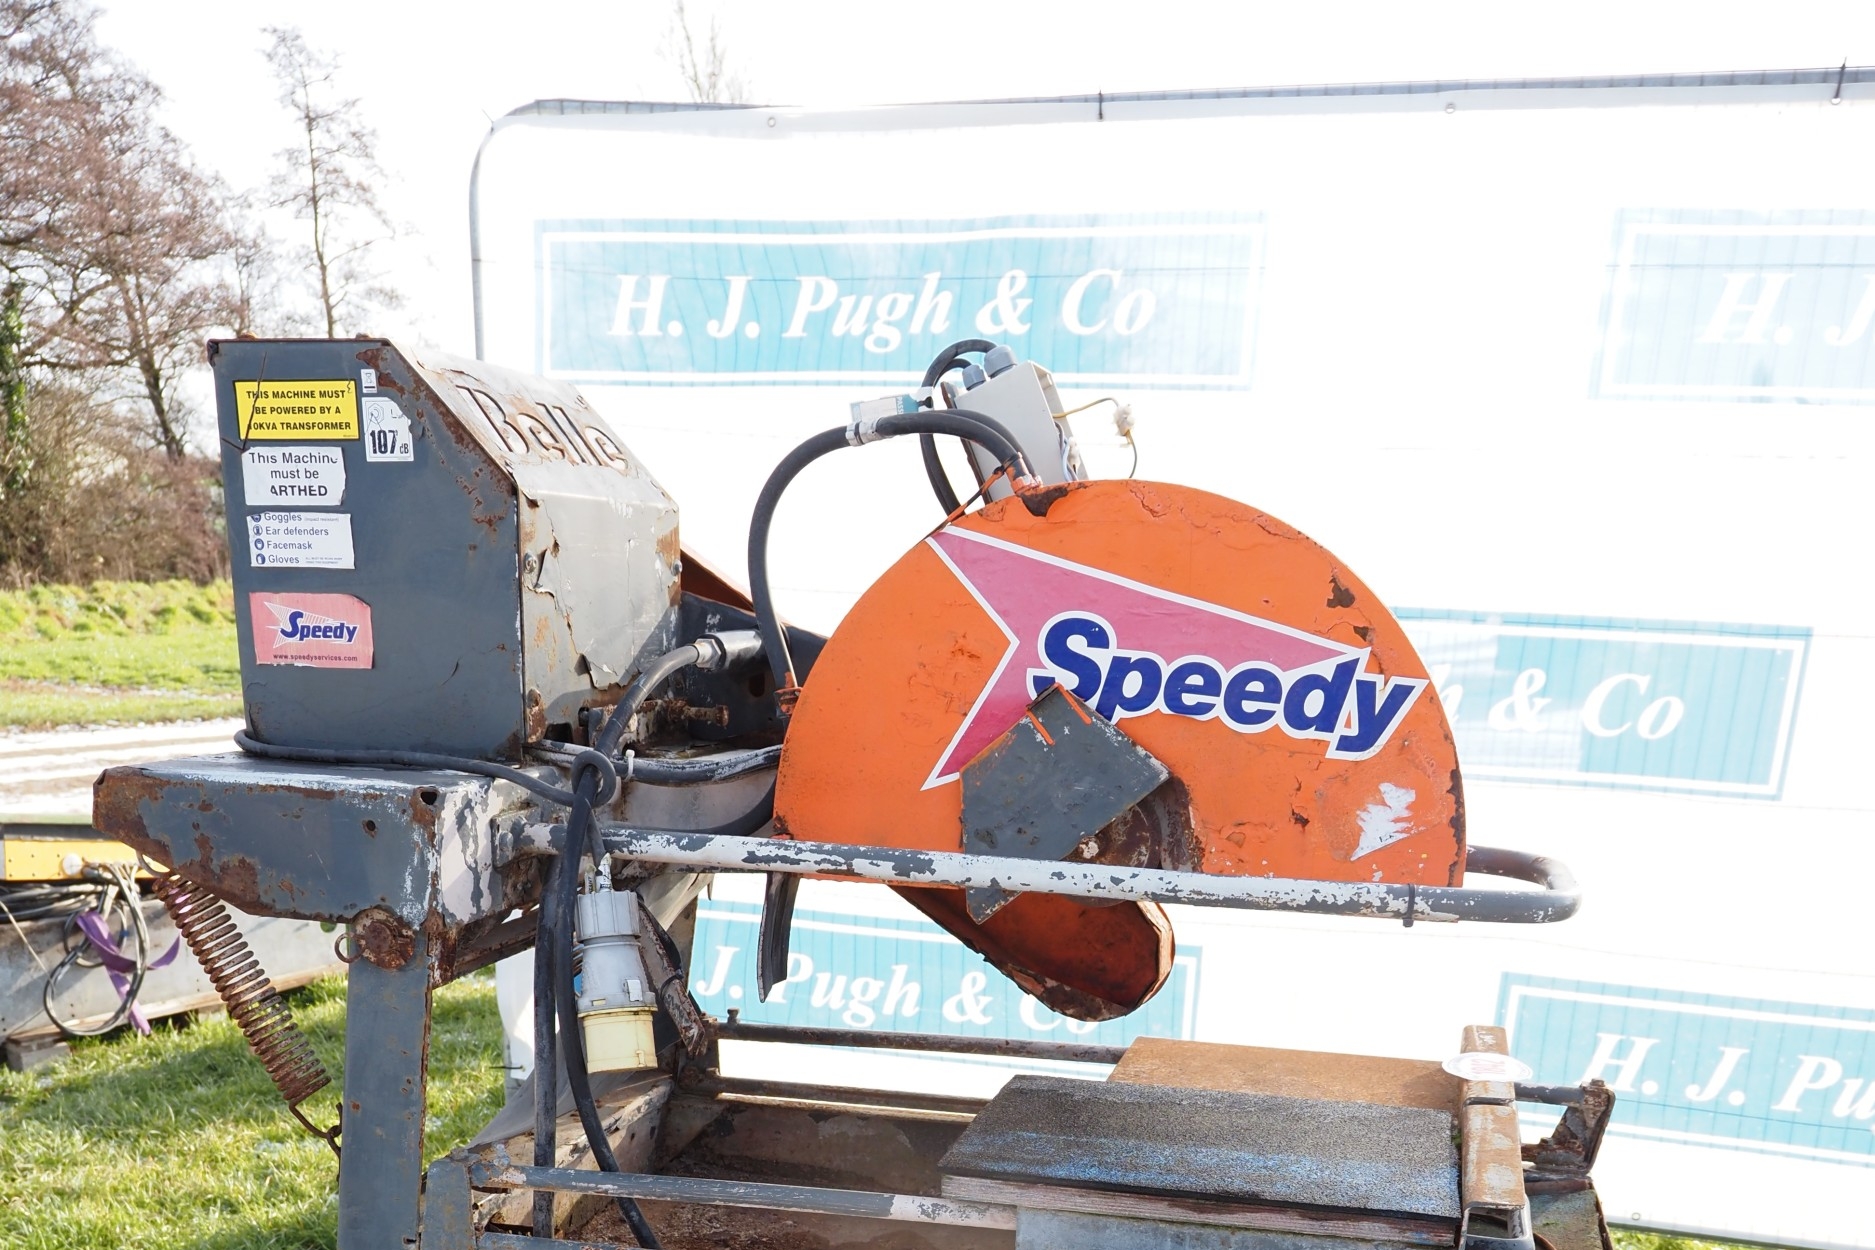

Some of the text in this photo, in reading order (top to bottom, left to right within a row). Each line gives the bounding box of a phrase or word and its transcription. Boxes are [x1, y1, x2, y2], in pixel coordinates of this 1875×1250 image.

[606, 267, 1158, 354] H. J. Pugh & Co
[1696, 272, 1875, 346] H. J
[246, 390, 346, 399] THIS MACHINE MUST
[254, 406, 341, 415] BE POWERED BY A
[280, 421, 351, 430] TRANSFORMER
[370, 430, 398, 454] 107
[249, 452, 277, 464] This
[270, 467, 319, 479] must be
[270, 485, 328, 496] ARTHED
[264, 512, 302, 523] Goggles
[265, 526, 329, 536] Ear defenders
[267, 540, 313, 550] Facemask
[268, 554, 300, 564] Gloves
[280, 611, 358, 642] Speedy
[273, 653, 358, 662] www.speedyservices.com
[1029, 613, 1428, 757] Speedy
[1487, 667, 1553, 733] &
[1580, 672, 1686, 740] Co
[696, 944, 744, 1001] J.
[765, 952, 922, 1028] Pugh
[942, 969, 993, 1026] &
[1575, 1031, 1875, 1132] H. J. Pu
